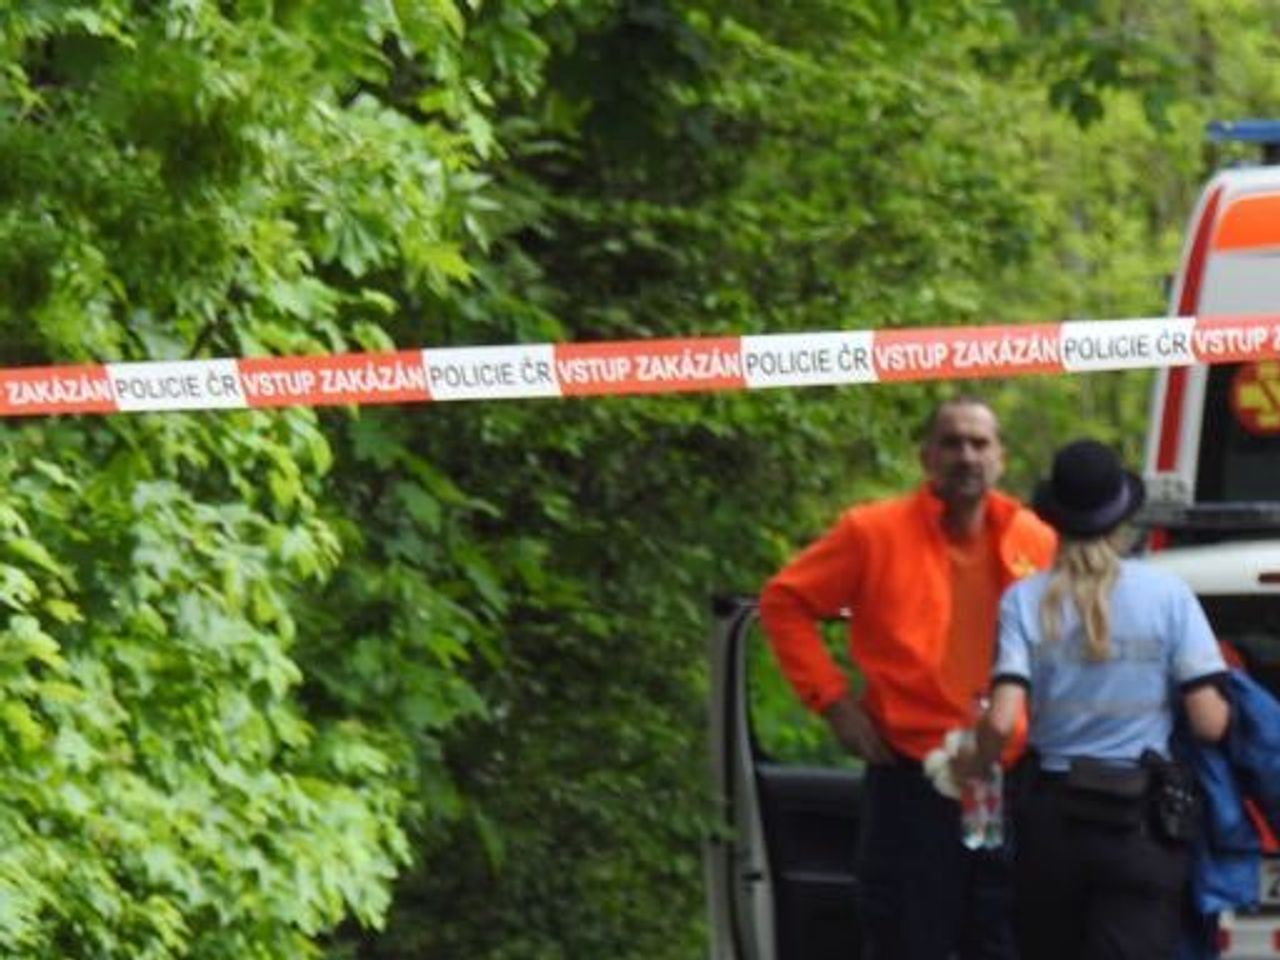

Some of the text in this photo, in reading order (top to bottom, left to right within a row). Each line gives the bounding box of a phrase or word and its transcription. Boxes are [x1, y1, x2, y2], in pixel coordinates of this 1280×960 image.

[117, 374, 200, 400] POLICIE
[207, 368, 237, 396] ČR
[241, 370, 315, 398] VSTUP
[321, 362, 425, 394] ZAKÁZÁN
[431, 361, 514, 388] POLICIE
[521, 356, 551, 384] ČR
[558, 357, 631, 384] VSTUP
[636, 348, 741, 381] ZAKÁZÁN
[746, 350, 830, 376] POLICIE
[838, 342, 867, 371] ČR
[874, 344, 947, 371] VSTUP
[952, 335, 1057, 366] ZAKÁZÁN
[1064, 334, 1149, 360] POLICIE
[1194, 328, 1267, 355] VSTUP
